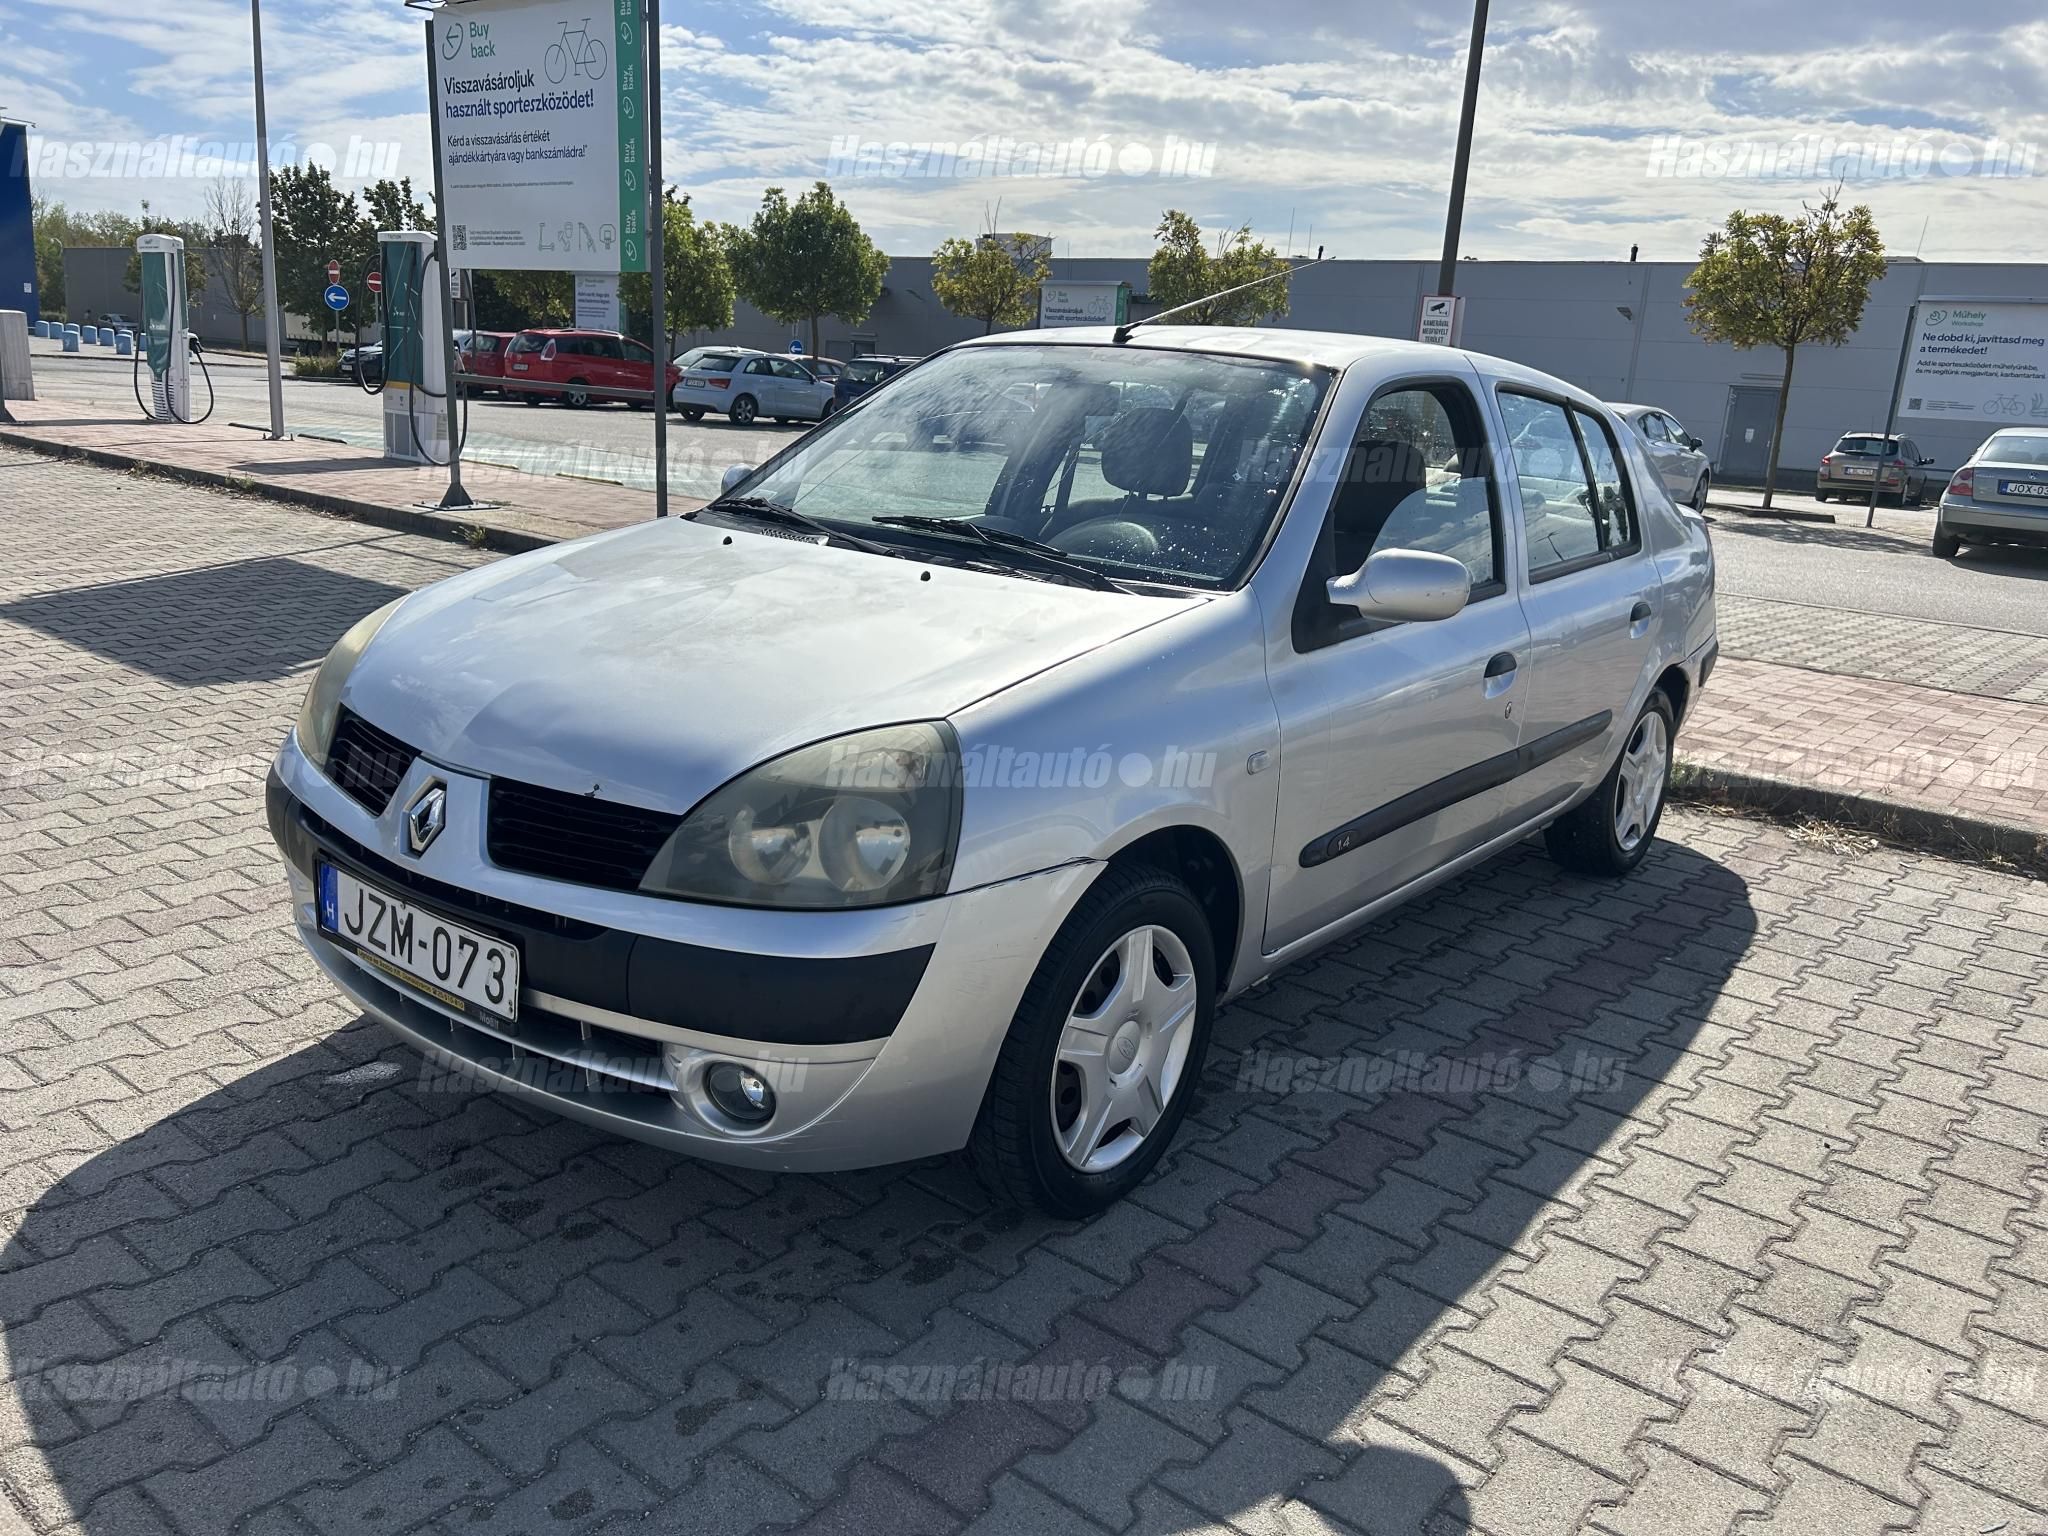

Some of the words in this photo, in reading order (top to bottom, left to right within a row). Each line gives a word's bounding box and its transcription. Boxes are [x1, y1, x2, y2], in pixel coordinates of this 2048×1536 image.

[469, 21, 489, 40] Buy
[470, 40, 496, 58] back
[444, 69, 535, 95] Visszavásároljuk
[445, 99, 492, 119] használt
[493, 88, 595, 119] sporteszközödet!
[447, 133, 465, 147] Kérd
[465, 136, 470, 146] a
[470, 131, 522, 146] visszavásárlás
[522, 129, 551, 143] értékét
[448, 149, 506, 166] ajándékkártyára
[506, 151, 525, 164] vagy
[1952, 310, 1986, 320] Műhely
[1922, 332, 1936, 341] Ne
[1937, 333, 1964, 342] dobd
[1964, 334, 1976, 344] ki,
[2022, 337, 2045, 347] meg
[1927, 345, 1988, 355] termékedet!
[326, 901, 335, 920] H
[345, 888, 506, 1005] JZM-073
